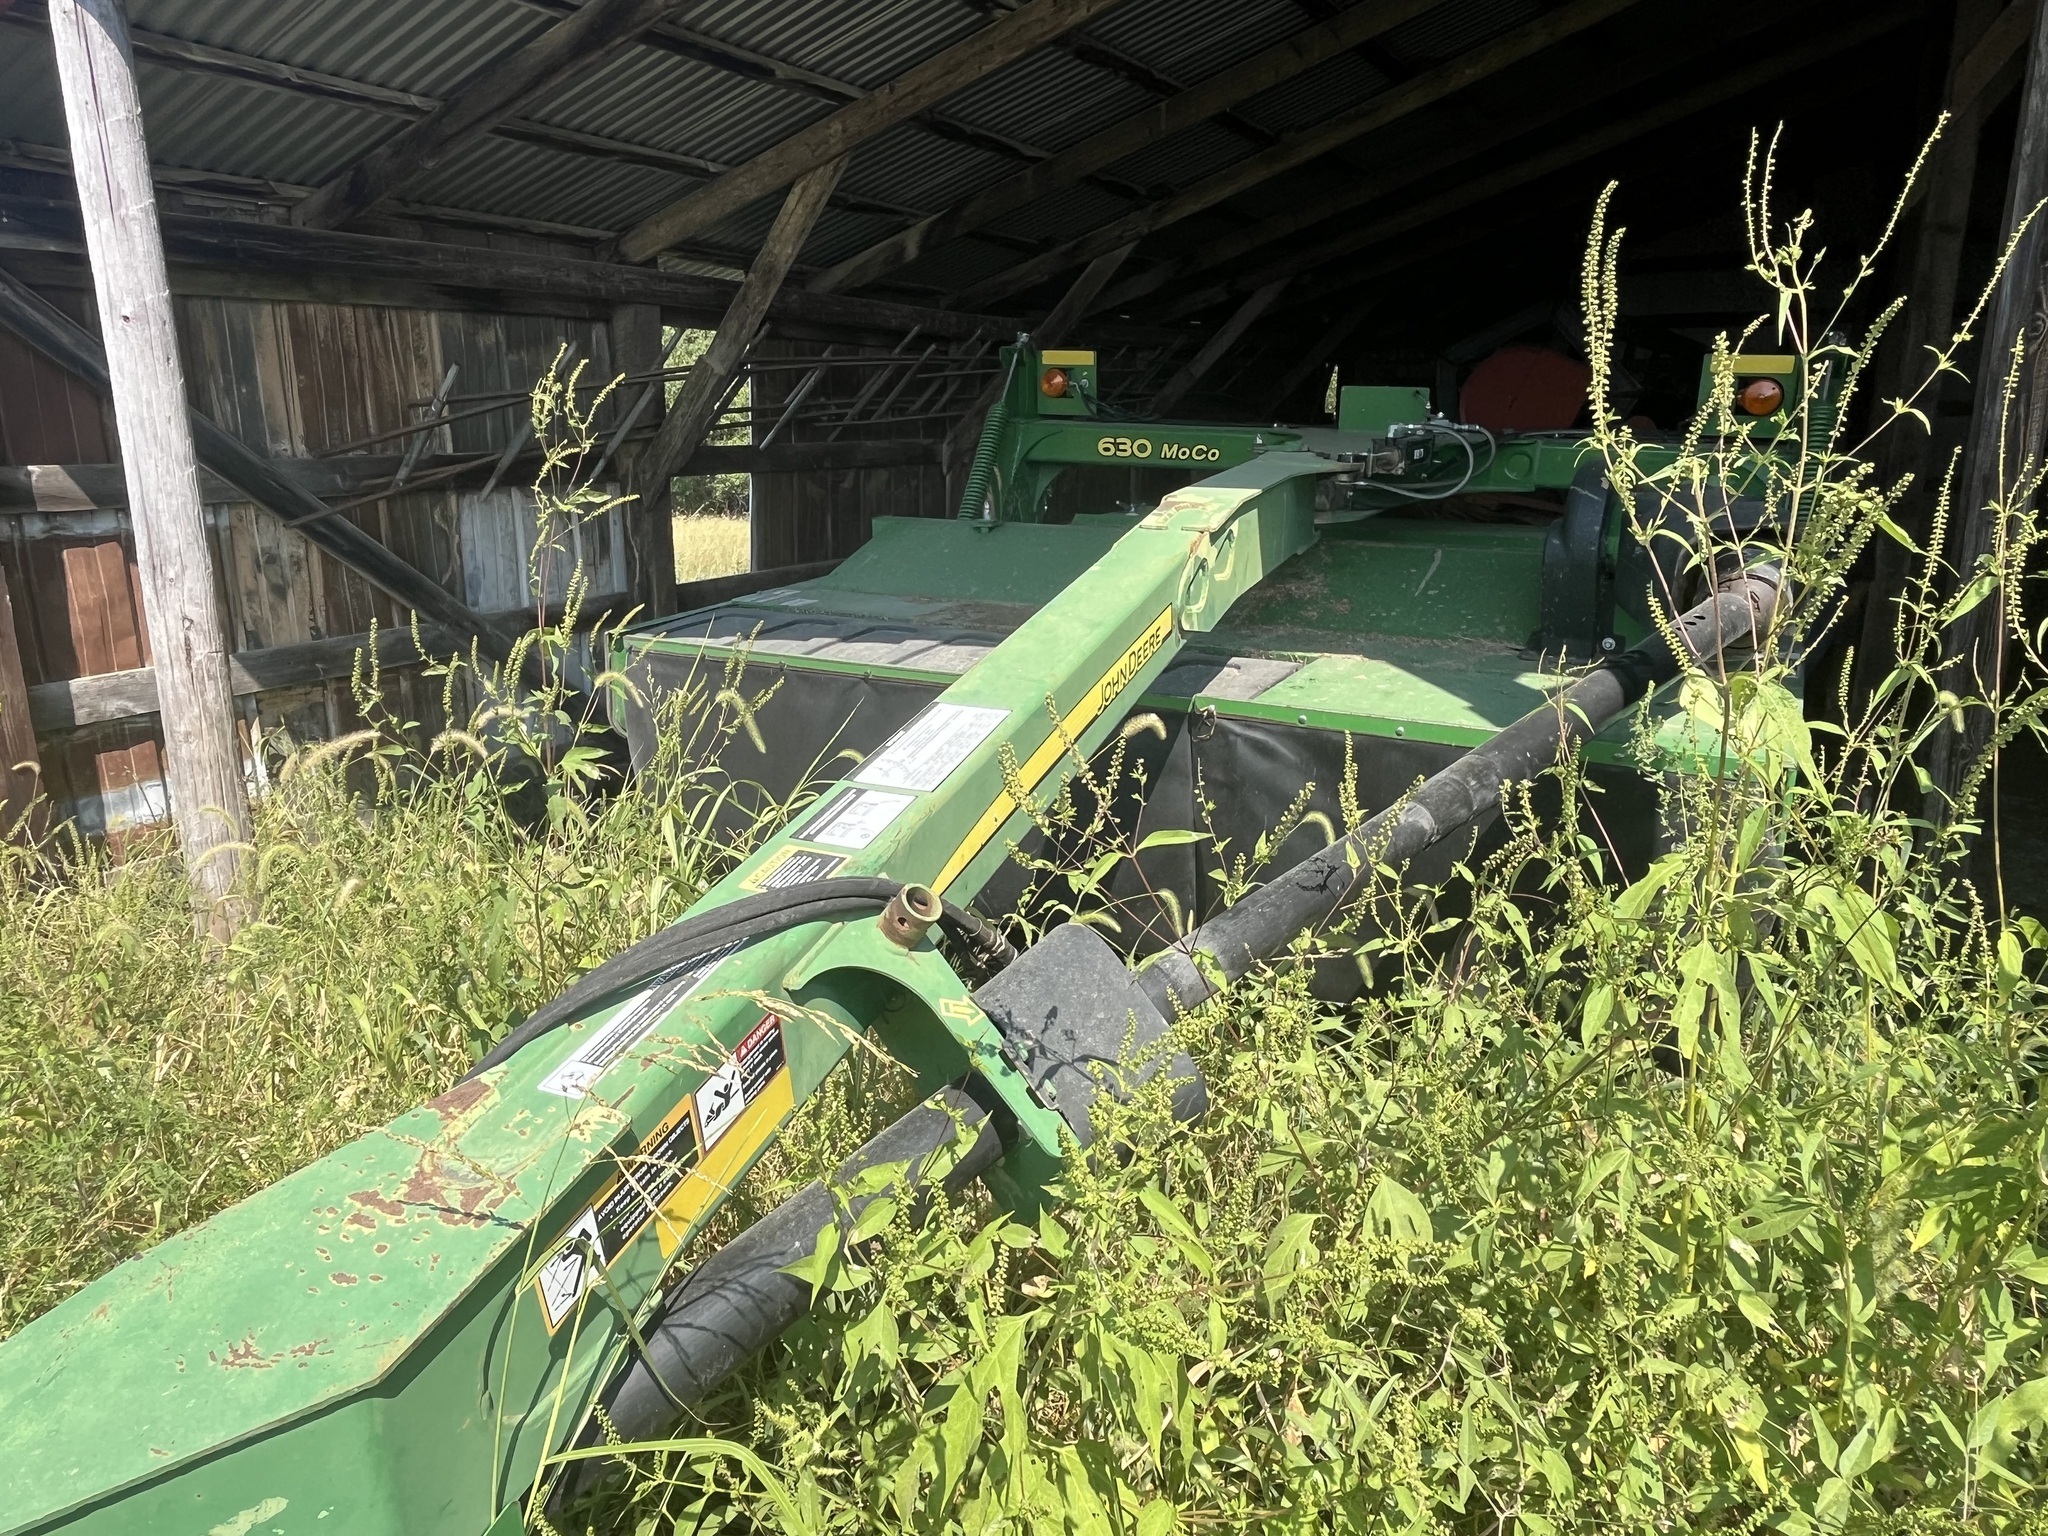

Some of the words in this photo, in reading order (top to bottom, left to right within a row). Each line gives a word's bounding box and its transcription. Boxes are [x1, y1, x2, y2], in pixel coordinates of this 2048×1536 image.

[1097, 437, 1152, 458] 630
[1160, 443, 1220, 461] MoCo
[1097, 663, 1128, 713] JOHN
[1128, 626, 1161, 677] DEERE
[747, 1014, 776, 1049] DANGER
